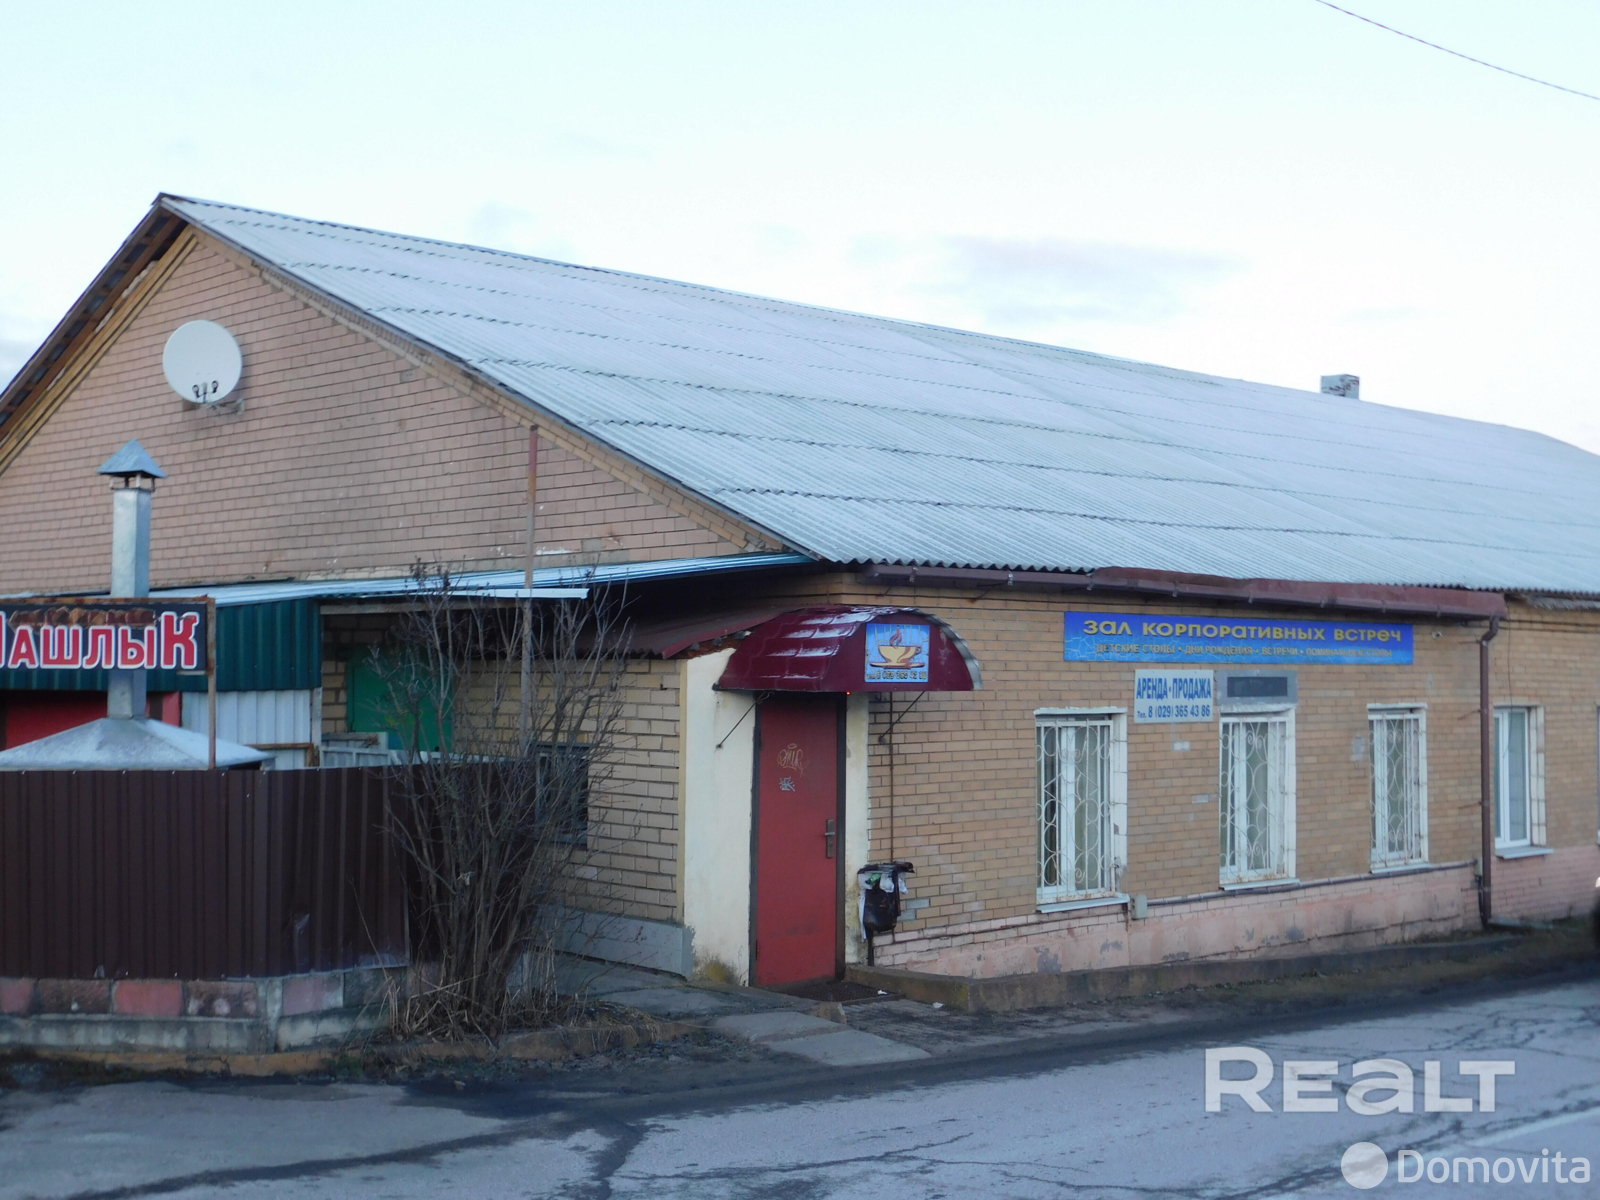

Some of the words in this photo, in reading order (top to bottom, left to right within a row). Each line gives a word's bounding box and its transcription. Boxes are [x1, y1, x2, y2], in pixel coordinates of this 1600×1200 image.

[0, 611, 199, 669] АШЛЫК
[1096, 643, 1140, 654] ДЕТСКИЕ
[1142, 644, 1175, 654] СТОЛЫ
[1148, 705, 1153, 718] 8
[1155, 705, 1173, 718] (029)
[1175, 705, 1188, 717] 365
[1190, 704, 1199, 717] 43
